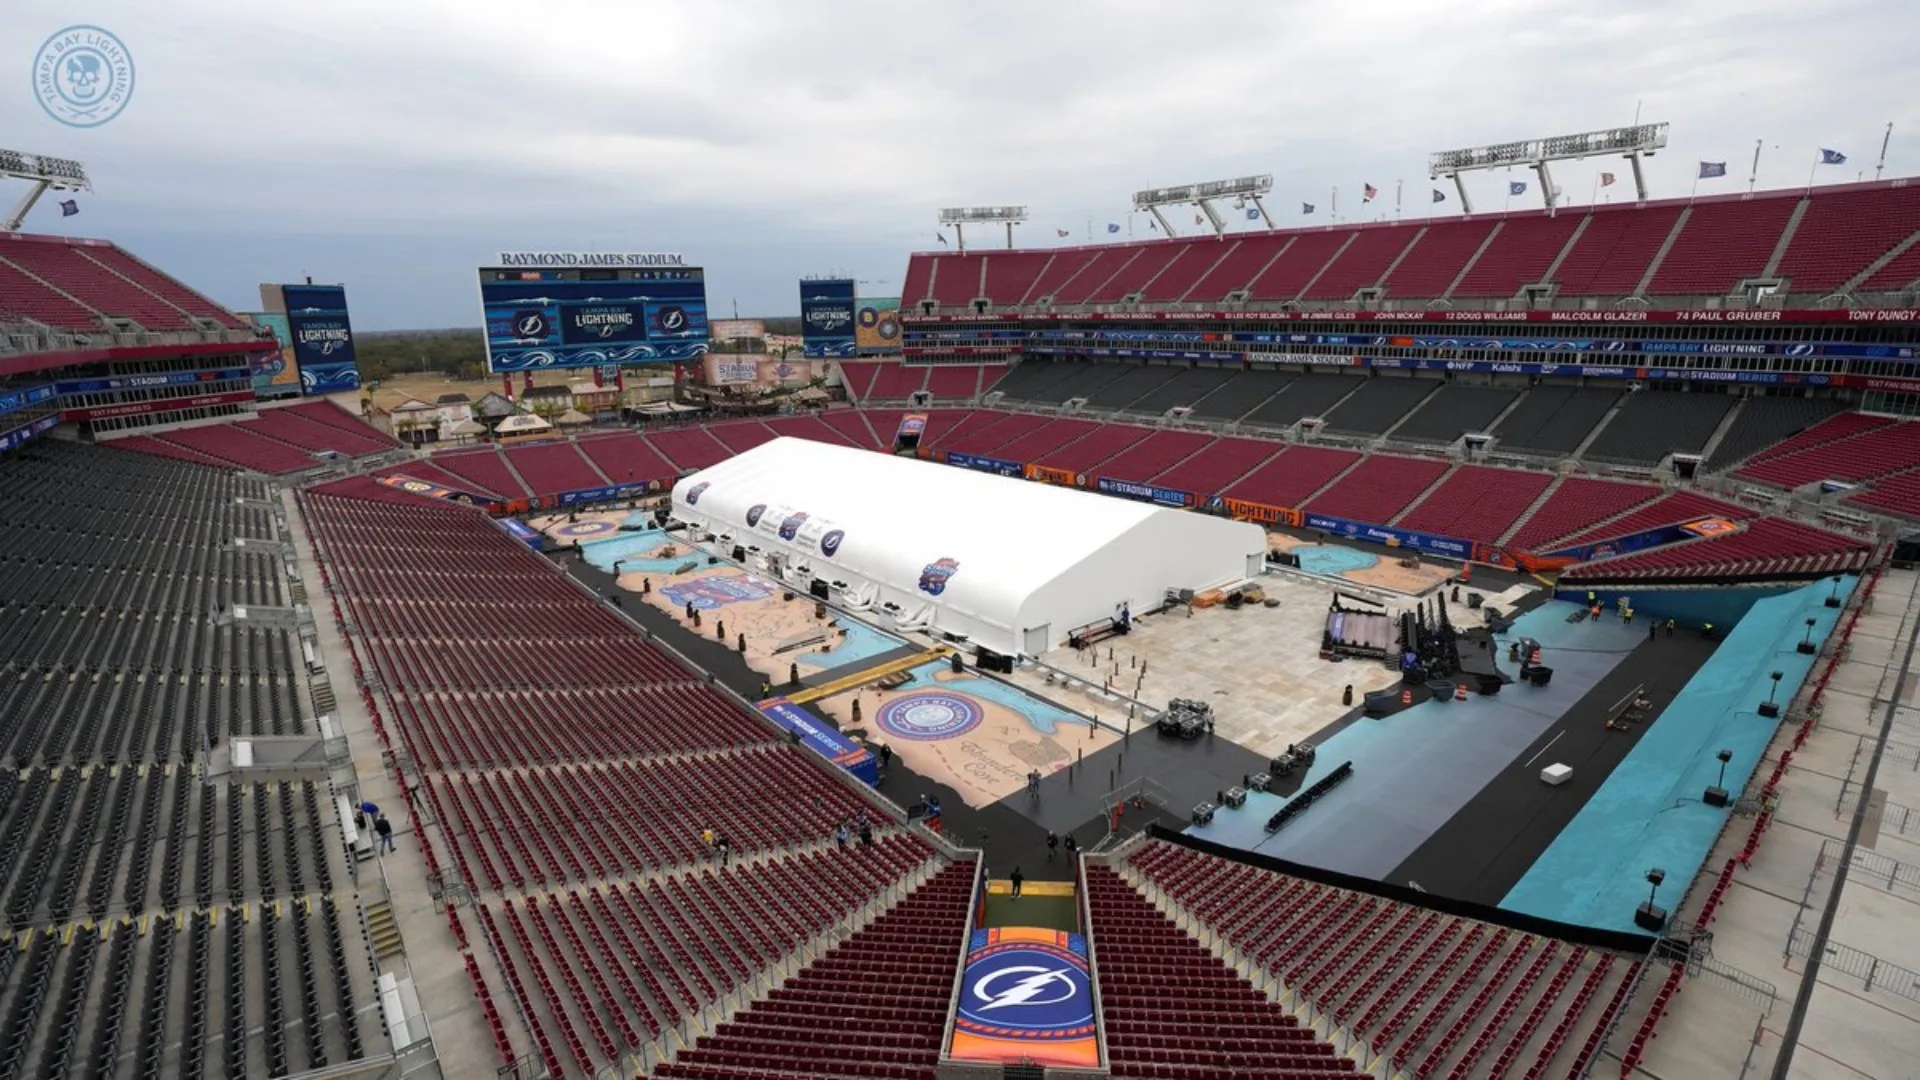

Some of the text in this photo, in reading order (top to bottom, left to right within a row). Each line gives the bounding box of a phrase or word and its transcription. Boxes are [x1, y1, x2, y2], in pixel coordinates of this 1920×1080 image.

[501, 252, 683, 266] RAYMOND JAMES STADIUM
[575, 312, 633, 328] LIGHTNING
[805, 311, 851, 322] LIGHTNING
[1334, 312, 1356, 320] GILES
[1446, 312, 1528, 320] 12 DOUG WILLIAMS
[1551, 312, 1648, 321] MALCOLM GLAZER
[1676, 311, 1782, 321] 74 PAUL GRUBER
[1848, 310, 1916, 321] TONY DUNGY
[299, 328, 349, 343] LIGHTNING
[1641, 343, 1766, 354] TAMPA BAY LIGHTNING
[131, 376, 168, 387] STADIUM
[1690, 370, 1778, 383] STADIUM SERIES
[89, 409, 105, 417] TEXT
[1115, 483, 1185, 503] STADIUM SERIES
[1227, 500, 1296, 525] LIGHTNING
